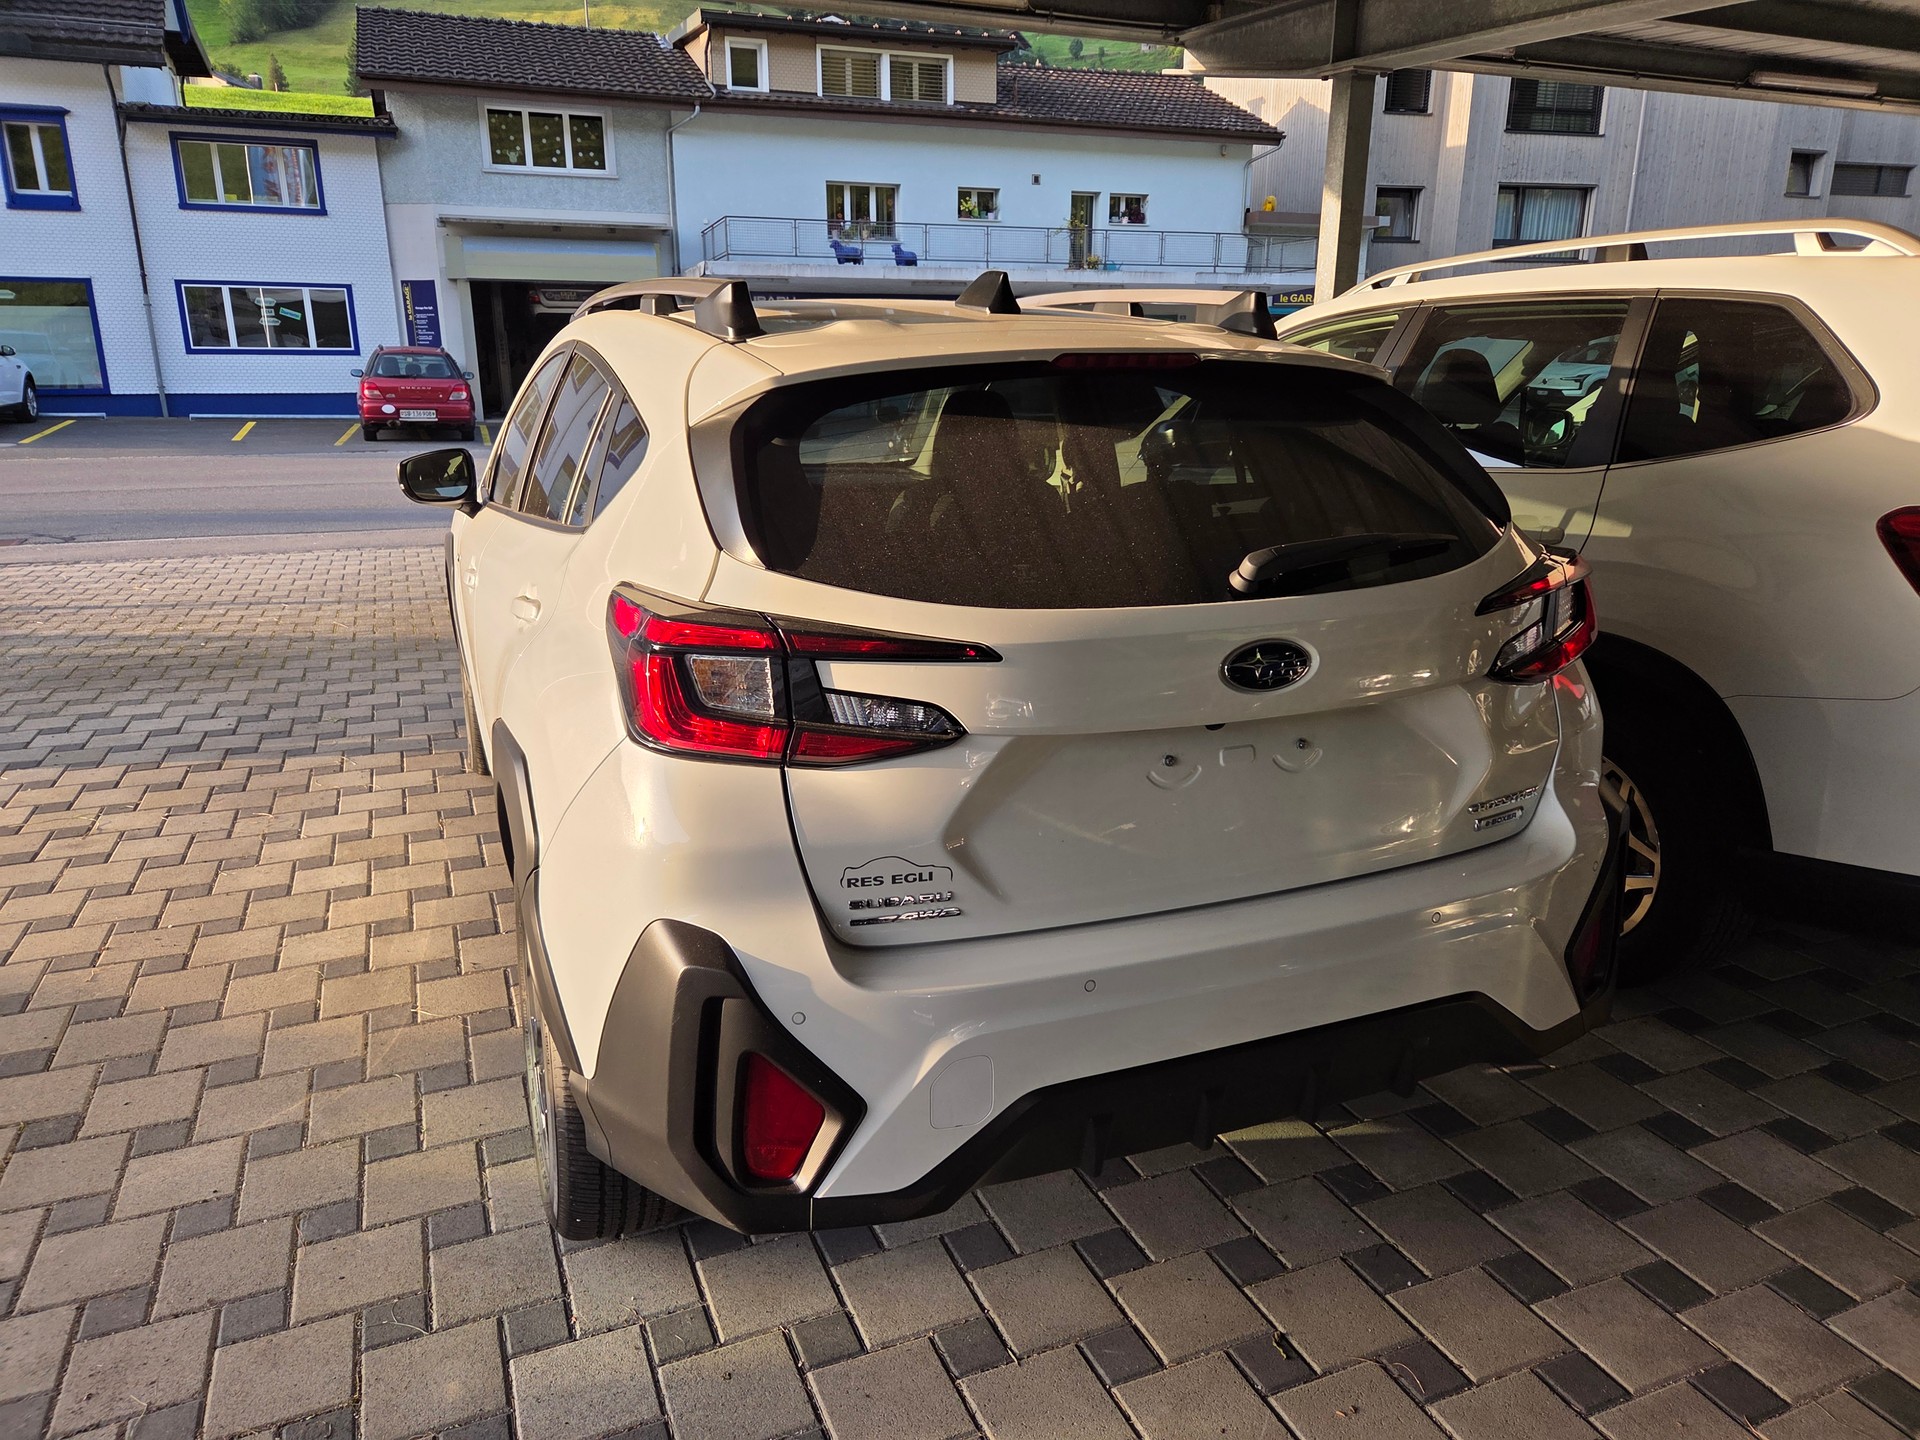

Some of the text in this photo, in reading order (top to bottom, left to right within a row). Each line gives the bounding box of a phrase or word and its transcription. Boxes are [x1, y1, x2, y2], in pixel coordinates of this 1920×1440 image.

[1280, 294, 1288, 303] le
[846, 871, 934, 888] RES EGLI
[848, 891, 953, 910] SUBARU
